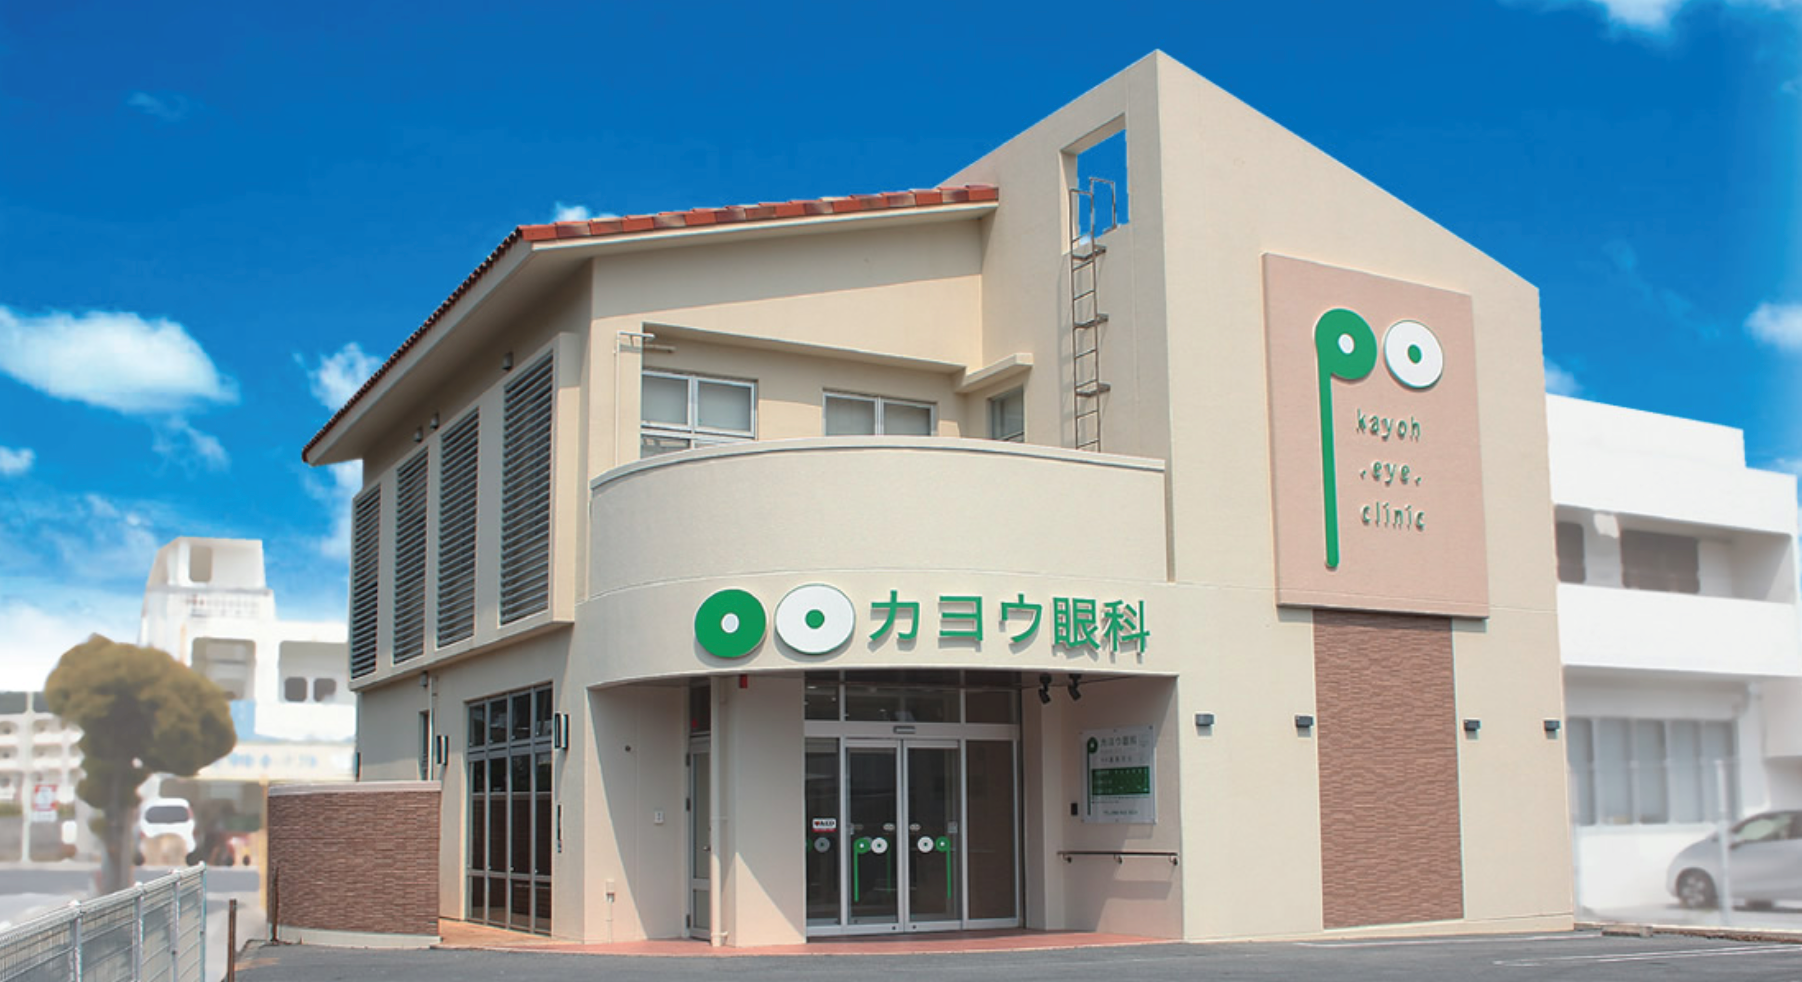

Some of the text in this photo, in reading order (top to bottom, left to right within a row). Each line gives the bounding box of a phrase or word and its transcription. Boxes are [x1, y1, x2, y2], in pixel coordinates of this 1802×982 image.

[1357, 408, 1421, 440] kayoh
[1361, 502, 1425, 530] clinic
[869, 590, 1150, 653] カヨウ眼科
